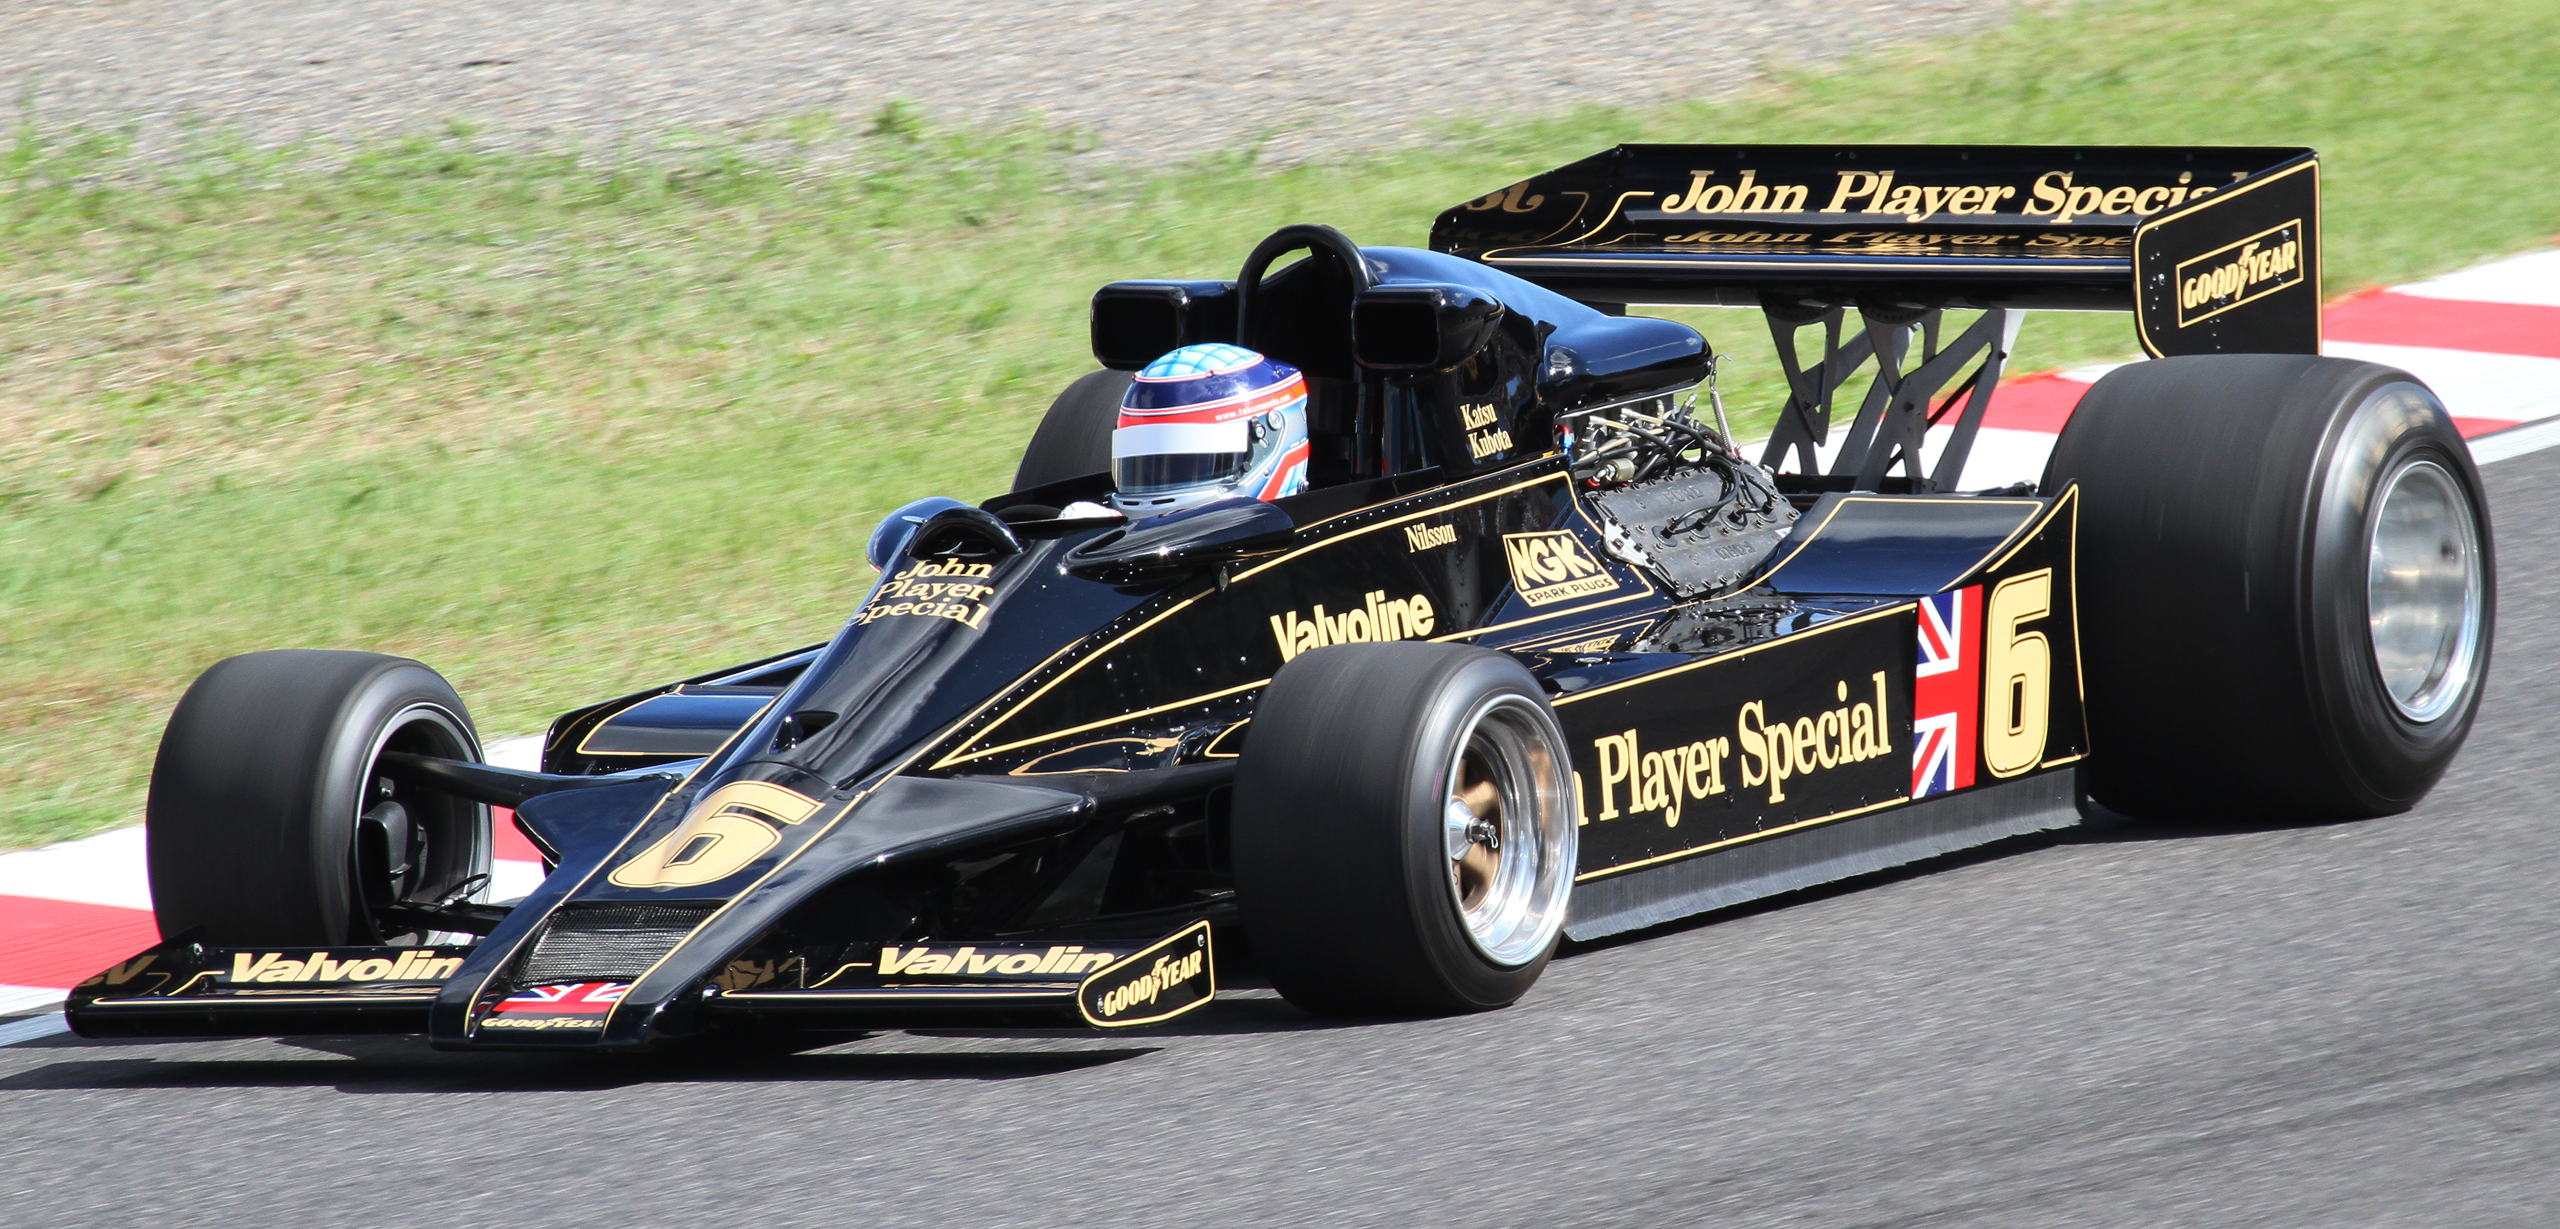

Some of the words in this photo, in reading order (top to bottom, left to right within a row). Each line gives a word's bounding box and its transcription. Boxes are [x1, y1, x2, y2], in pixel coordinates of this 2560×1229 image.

[1660, 169, 1809, 214] John
[1819, 169, 2016, 223] Player
[2022, 171, 2249, 223] Speci
[1460, 403, 1499, 431] Katsu
[1467, 427, 1514, 459] Kubota
[1404, 522, 1457, 553] Nilsson
[895, 557, 994, 580] John
[1508, 535, 1596, 590] NGK
[869, 578, 994, 602] Player
[1526, 587, 1568, 604] SPARK
[1572, 577, 1614, 595] PLUGS
[848, 598, 990, 630] Special
[1269, 589, 1435, 664] Valvoline
[1983, 567, 2053, 778] 6
[1594, 729, 1730, 828] Player
[1738, 670, 1893, 804] Special
[607, 780, 827, 888] 6
[230, 950, 465, 983] Valvolin
[878, 945, 1115, 974] Valvolin
